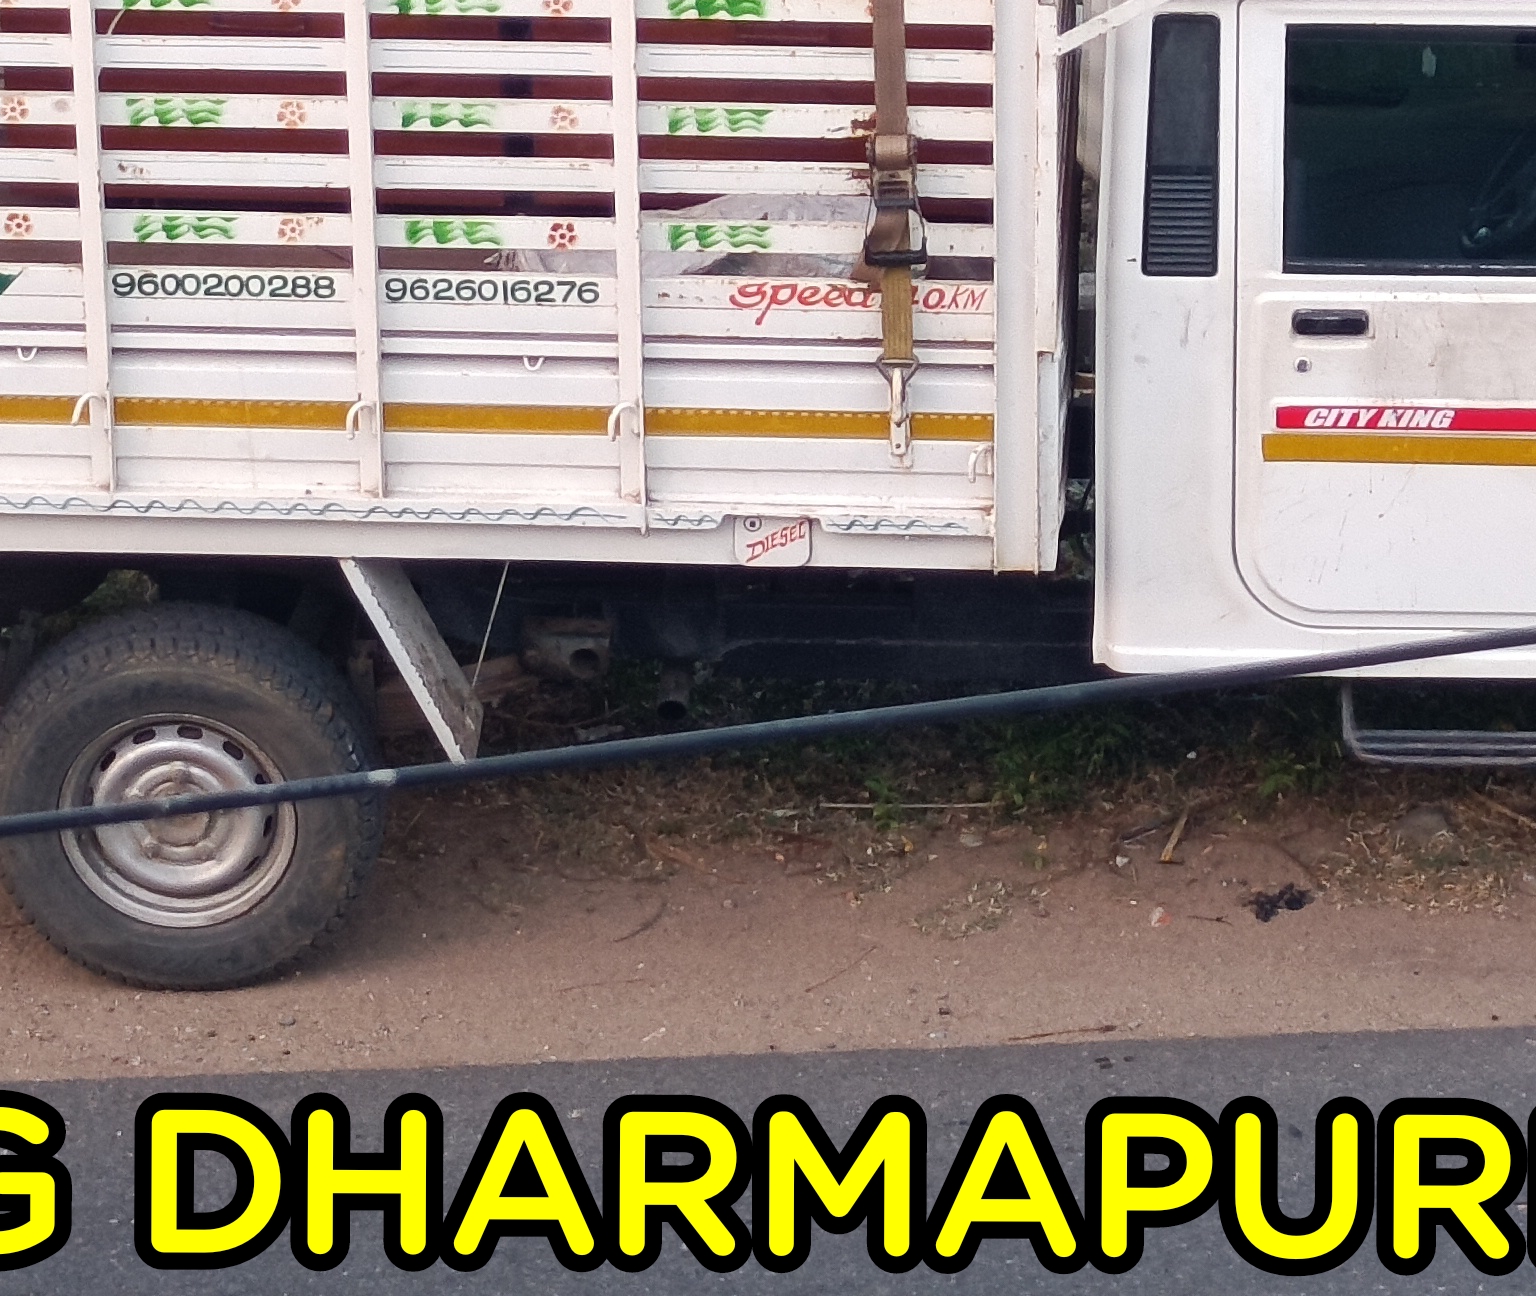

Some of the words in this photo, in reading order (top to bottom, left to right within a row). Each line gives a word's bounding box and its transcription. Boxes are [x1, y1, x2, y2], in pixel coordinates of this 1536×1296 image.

[112, 272, 336, 299] 9600200288
[384, 278, 600, 304] 9626016276
[1304, 408, 1379, 428] CITY
[1376, 409, 1456, 429] KING
[745, 519, 807, 564] DIESEL
